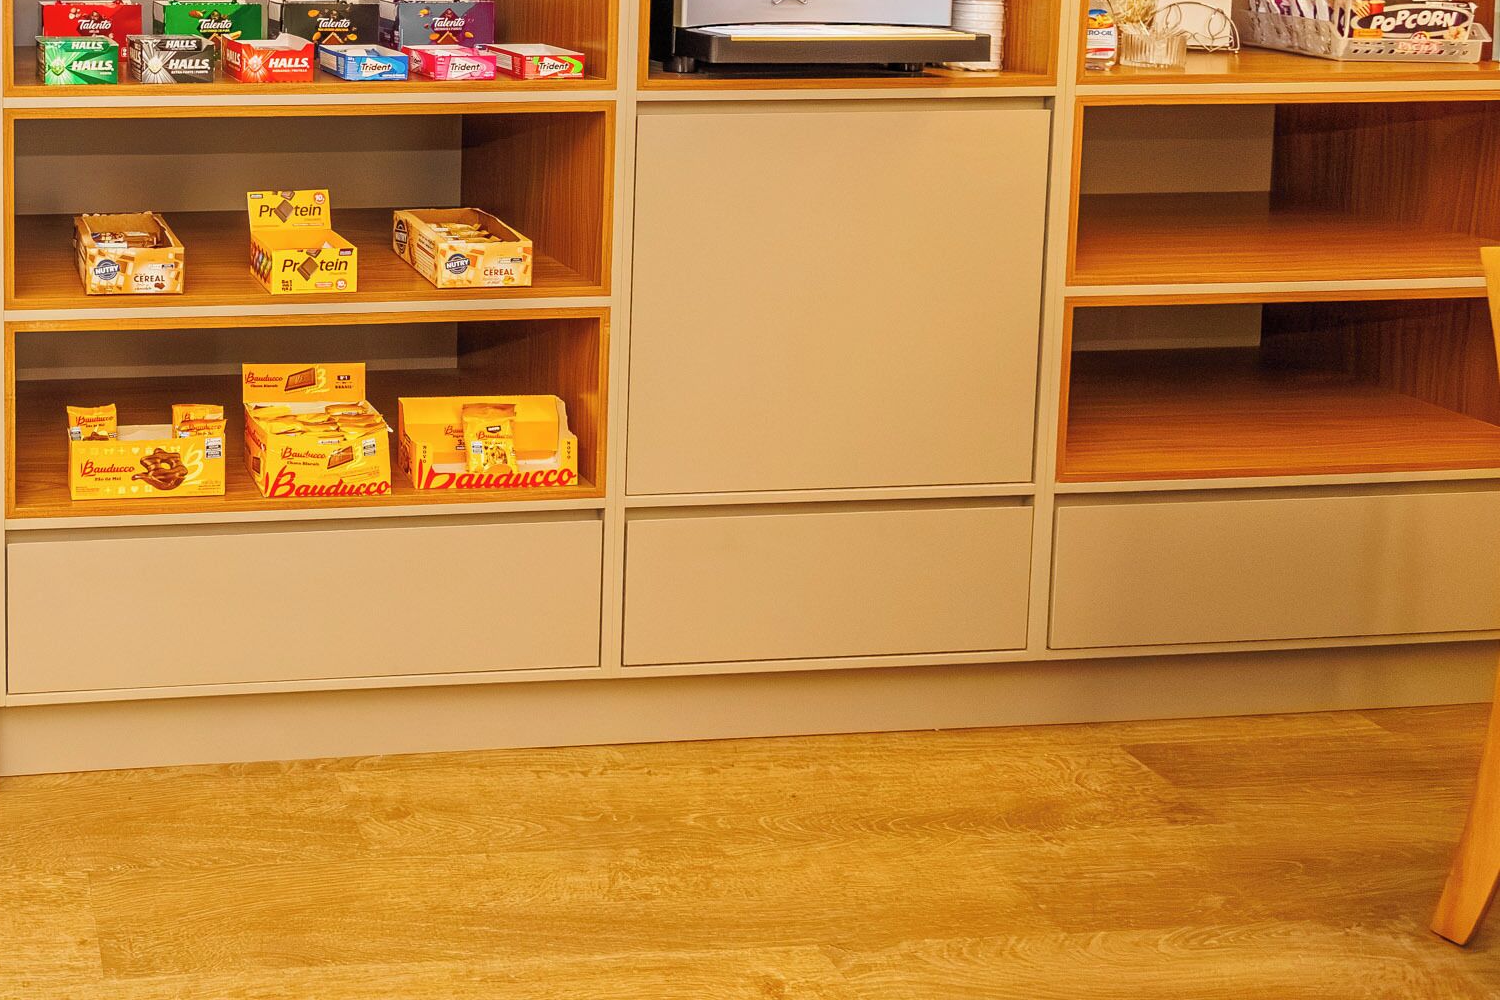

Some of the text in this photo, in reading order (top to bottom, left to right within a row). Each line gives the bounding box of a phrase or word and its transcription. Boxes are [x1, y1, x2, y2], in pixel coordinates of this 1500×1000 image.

[78, 19, 111, 30] Talento
[199, 19, 232, 30] Talento
[317, 17, 350, 29] Talento
[432, 16, 465, 28] Talento
[1370, 10, 1458, 32] POPCORN
[71, 41, 104, 50] HALLS
[166, 40, 198, 49] HALLS
[72, 60, 114, 71] HALLS
[169, 58, 208, 70] HALLS
[269, 57, 309, 69] HALLS
[360, 63, 392, 71] Trident
[450, 63, 481, 71] Trident
[538, 62, 570, 70] Trident
[259, 203, 322, 218] Prtein
[94, 264, 120, 276] NUTRY
[282, 258, 348, 273] Prtein
[446, 258, 470, 270] NUTRY
[483, 268, 515, 276] CEREAL
[133, 274, 165, 283] CEREAL
[245, 371, 283, 385] Bauducco
[76, 415, 114, 426] Bauducco
[281, 446, 326, 460] Bauducco
[80, 459, 135, 477] Bauducco
[265, 465, 391, 498] Bauducco
